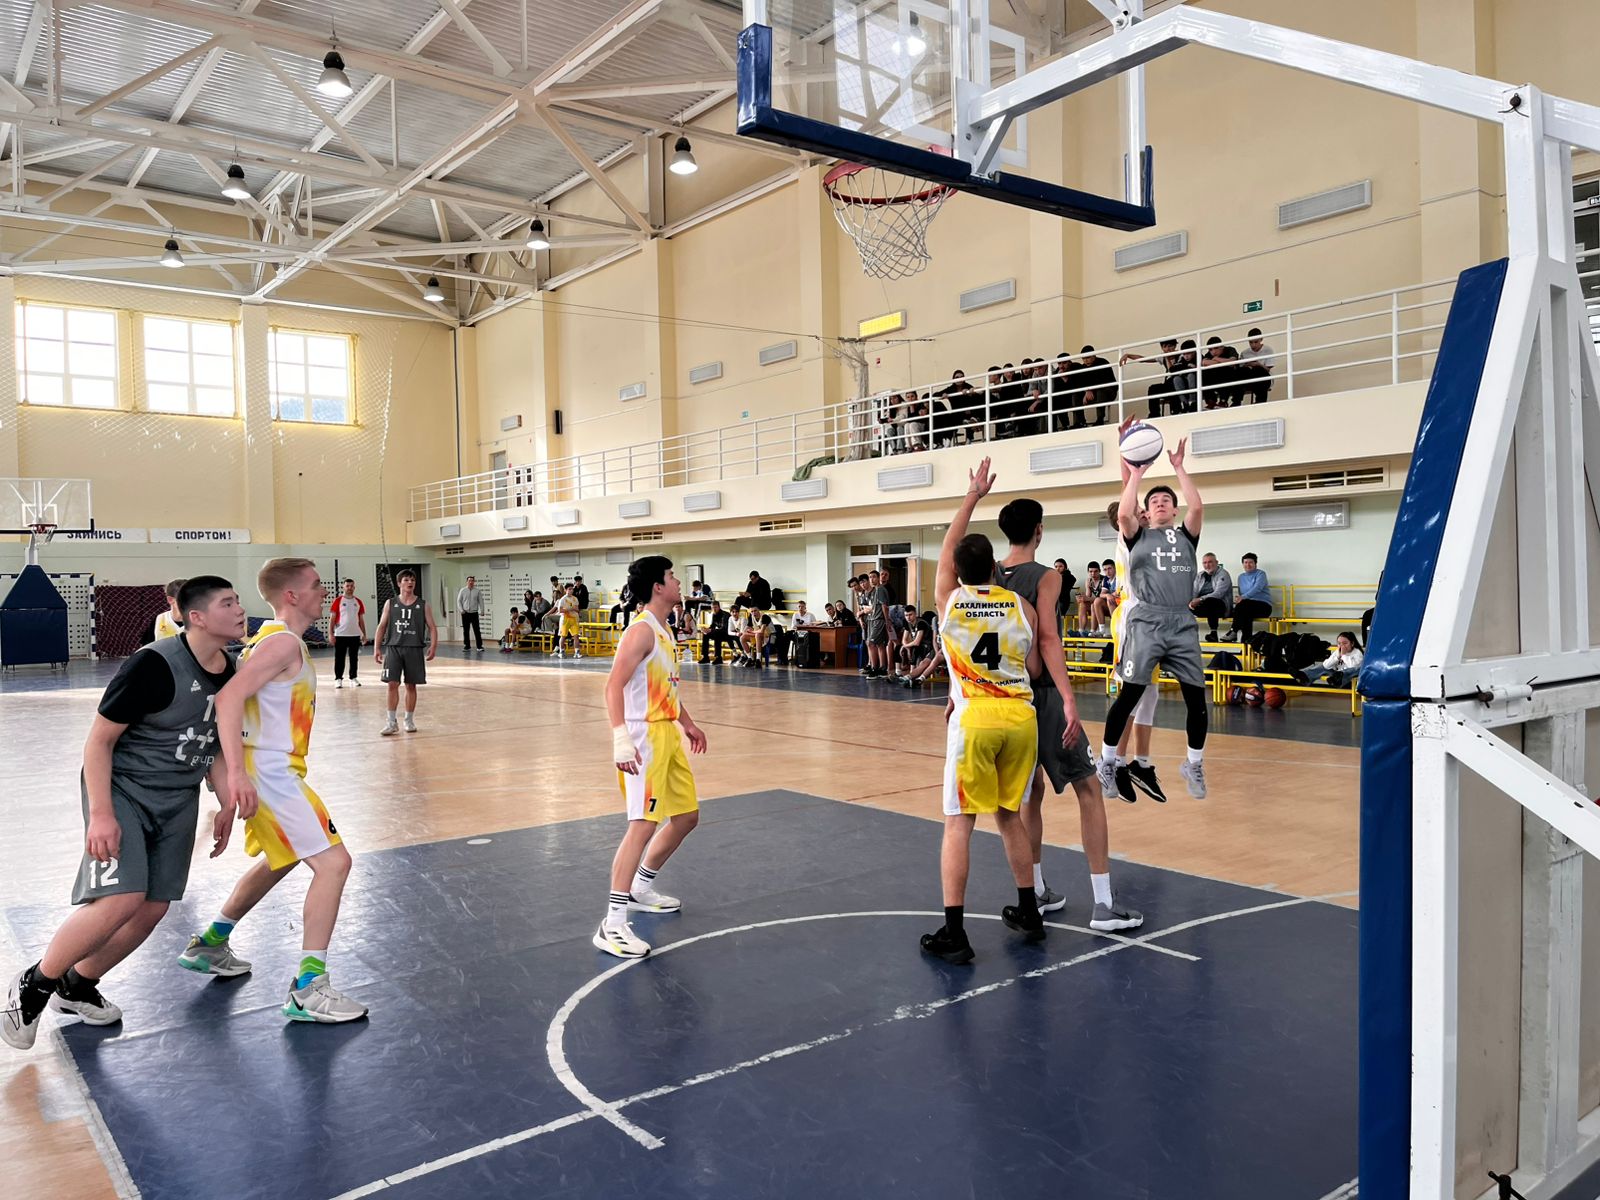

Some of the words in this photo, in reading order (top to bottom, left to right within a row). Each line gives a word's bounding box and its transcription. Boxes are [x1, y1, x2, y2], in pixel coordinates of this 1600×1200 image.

[175, 531, 231, 540] СПОРТОМ!
[1165, 529, 1177, 544] 8
[1171, 565, 1192, 573] group
[401, 609, 411, 619] 11
[970, 632, 1002, 670] 4
[1124, 660, 1133, 677] 8
[203, 695, 217, 722] 1
[649, 799, 657, 812] 7
[90, 857, 119, 889] 12
